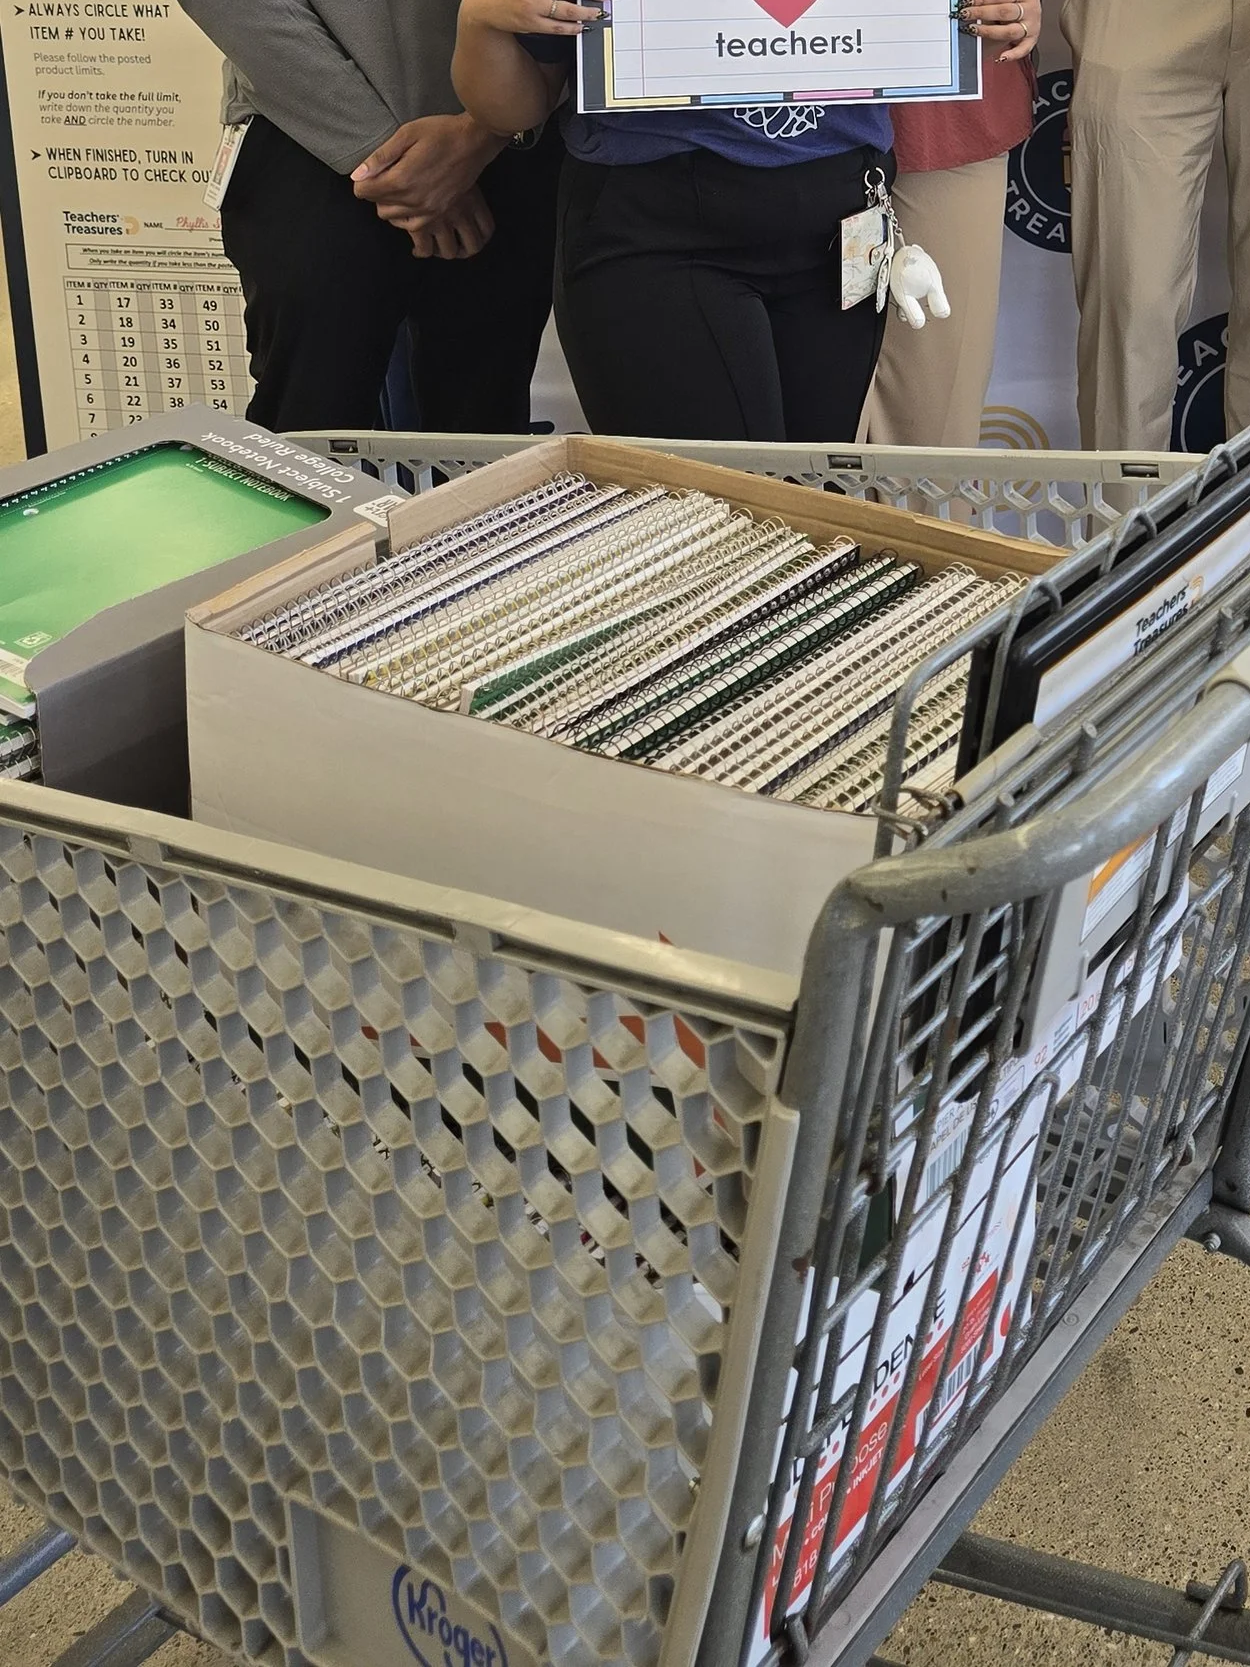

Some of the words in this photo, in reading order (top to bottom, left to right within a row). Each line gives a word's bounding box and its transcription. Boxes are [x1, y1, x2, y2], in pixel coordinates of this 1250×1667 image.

[28, 3, 80, 17] ALWAYS
[84, 4, 128, 18] CIRCLE
[132, 4, 170, 18] WHAT
[30, 26, 60, 40] ITEM
[65, 28, 74, 38] #
[79, 27, 105, 40] YOU
[109, 28, 146, 41] TAKE!
[716, 29, 863, 58] teachers!
[34, 52, 65, 62] Please
[67, 53, 97, 63] follow
[99, 54, 115, 63] the
[117, 54, 151, 65] posted
[35, 65, 74, 76] product
[38, 90, 46, 99] If
[46, 92, 65, 101] you
[68, 91, 93, 100] don't
[96, 91, 117, 100] take
[119, 92, 136, 101] the
[137, 92, 154, 101] full
[156, 92, 182, 103] limit,
[39, 103, 63, 112] write
[65, 103, 92, 112] down
[94, 104, 110, 113] the
[112, 105, 154, 116] quantity
[155, 107, 175, 116] you
[41, 115, 62, 124] take
[64, 115, 87, 125] AND
[88, 116, 114, 125] circle
[117, 117, 133, 126] the
[134, 117, 175, 127] number.
[46, 147, 81, 161] WHEN
[85, 148, 141, 164] FINISHED,
[145, 150, 177, 164] TURN
[181, 151, 194, 164] IN
[48, 166, 117, 181] CLIPBOARD
[122, 168, 139, 181] TO
[144, 169, 187, 183] CHECK
[64, 223, 123, 235] Treasures
[109, 281, 128, 289] ITEM
[195, 284, 215, 292] ITEM
[77, 295, 83, 305] 1
[116, 297, 131, 308] 17
[159, 299, 174, 310] 33
[203, 300, 217, 311] 49
[78, 315, 86, 325] 2
[119, 317, 133, 328] 18
[161, 319, 176, 330] 34
[205, 320, 220, 331] 50
[80, 334, 87, 345] 3
[121, 337, 135, 347] 19
[163, 339, 178, 349] 35
[206, 340, 221, 351] 51
[82, 354, 90, 364] 4
[122, 356, 137, 367] 20
[165, 358, 180, 369] 36
[208, 360, 223, 371] 52
[84, 374, 92, 384] 5
[125, 376, 139, 387] 21
[167, 378, 182, 389] 37
[210, 380, 225, 390] 53
[86, 393, 94, 404] 6
[127, 396, 141, 406] 22
[169, 397, 184, 408] 38
[212, 399, 228, 410] 54
[88, 413, 96, 424] 7
[201, 432, 281, 471] Notebook
[242, 433, 296, 457] Ruled
[294, 453, 354, 484] College
[240, 476, 294, 502] NOTEBOOK
[277, 466, 342, 499] Subject
[335, 495, 352, 504] 1
[852, 1446, 884, 1490] INKJET
